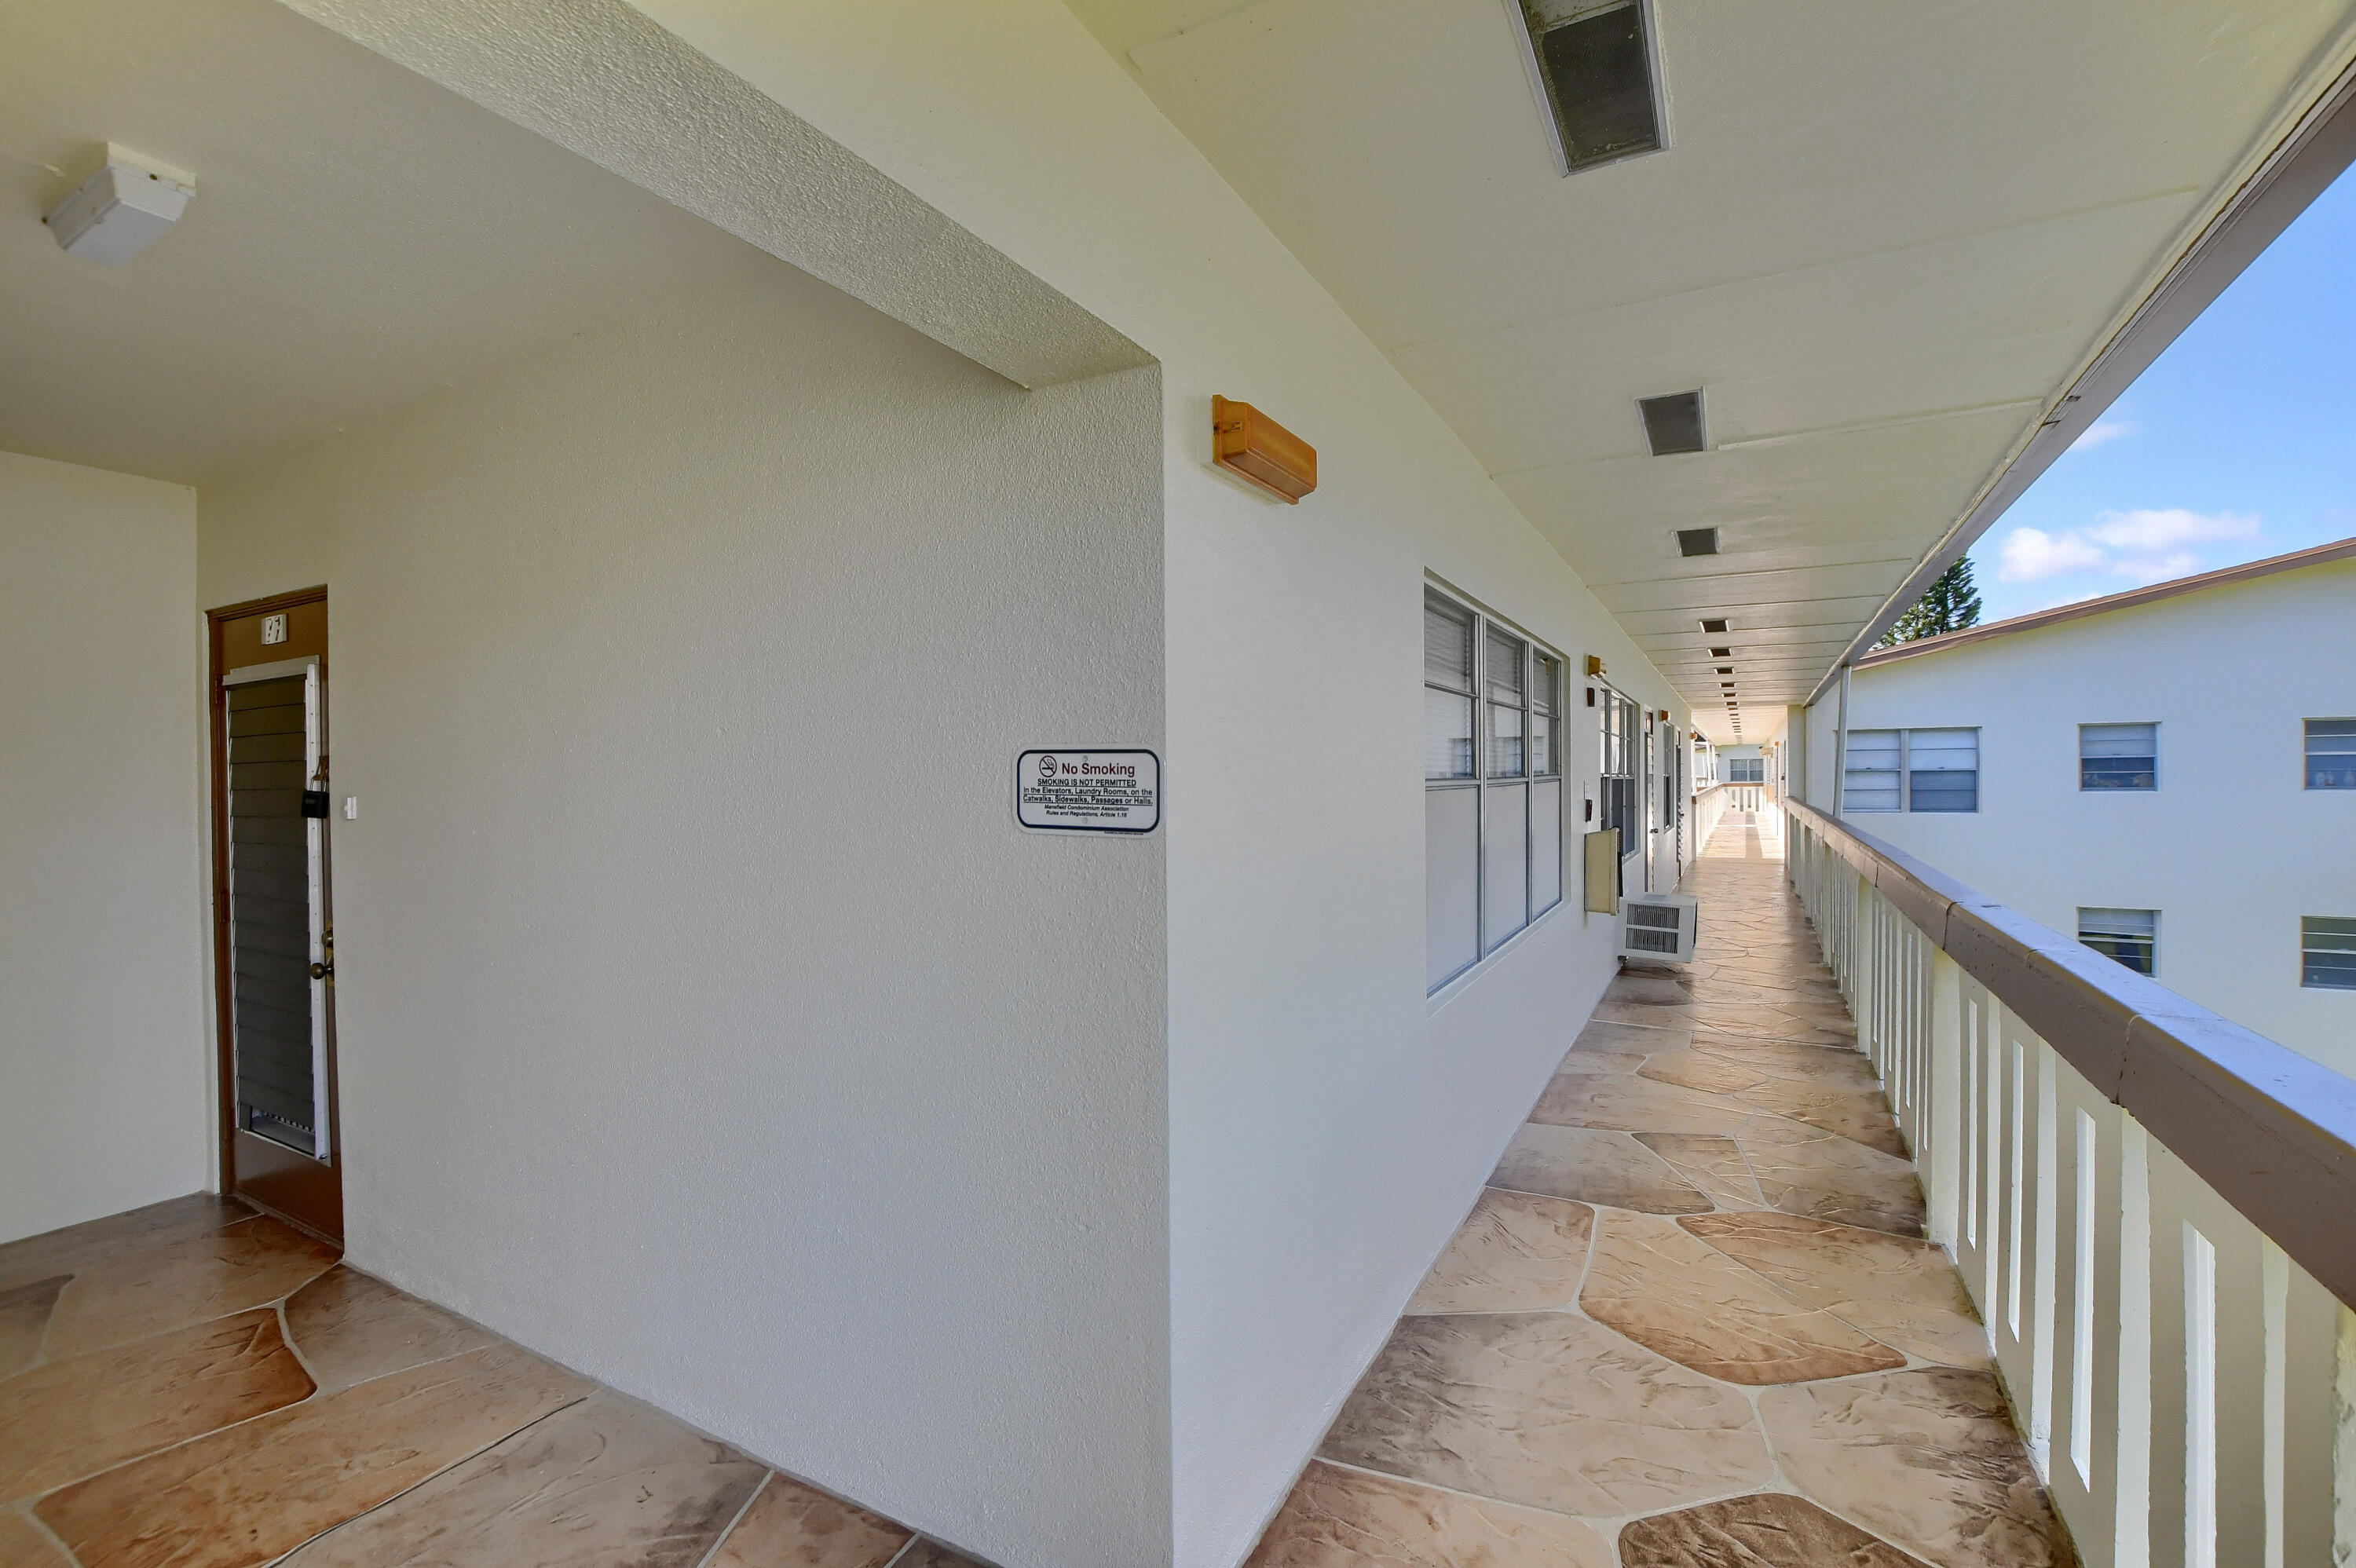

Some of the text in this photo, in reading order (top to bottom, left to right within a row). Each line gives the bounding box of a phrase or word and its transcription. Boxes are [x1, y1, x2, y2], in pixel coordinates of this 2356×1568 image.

[1062, 762, 1136, 777] No Smoking
[1042, 787, 1074, 795] Elevators,
[1023, 795, 1054, 803] Catwalks,
[1055, 795, 1089, 804] Sidewalks,
[1091, 796, 1123, 805] Passages
